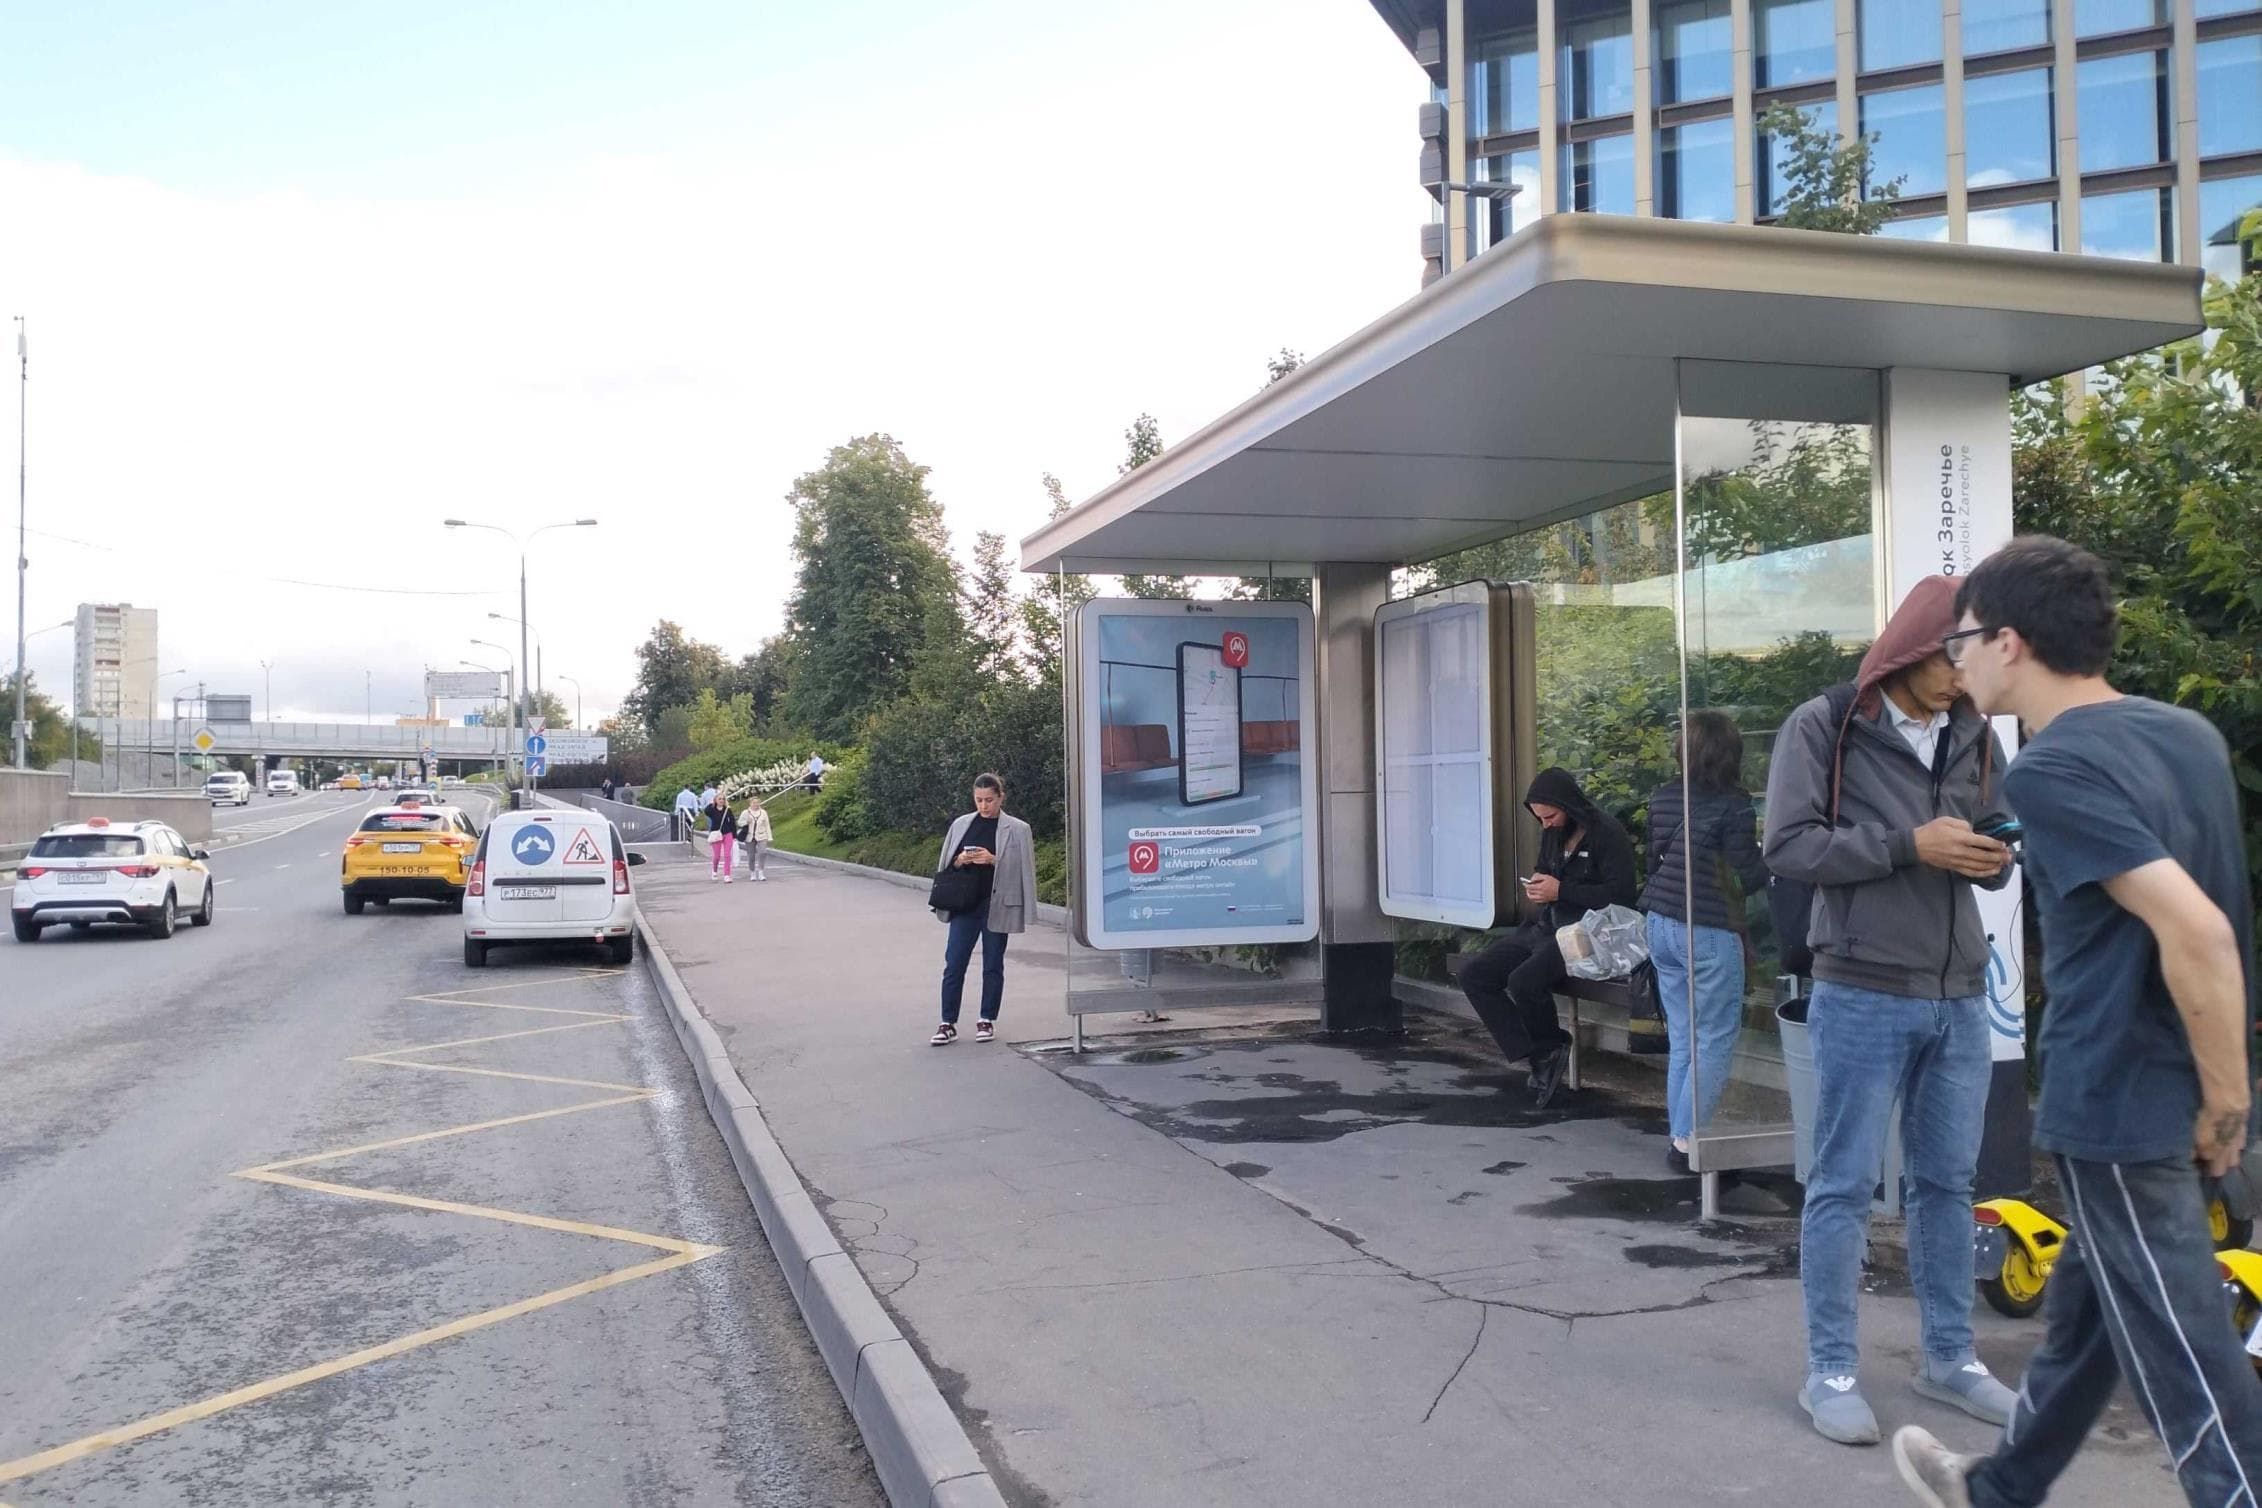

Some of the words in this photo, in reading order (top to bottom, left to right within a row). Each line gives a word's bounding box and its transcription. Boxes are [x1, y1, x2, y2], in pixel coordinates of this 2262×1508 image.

[1937, 444, 1956, 543] Заречье
[1958, 445, 1973, 516] Zarechye
[1958, 521, 1973, 576] osyolok
[1942, 550, 1957, 576] ок
[1134, 830, 1167, 838] Выбрать
[1193, 827, 1235, 836] свободный
[1164, 846, 1232, 857] Приложение
[1164, 859, 1208, 869] «Метро
[1209, 857, 1258, 867] Москвы»
